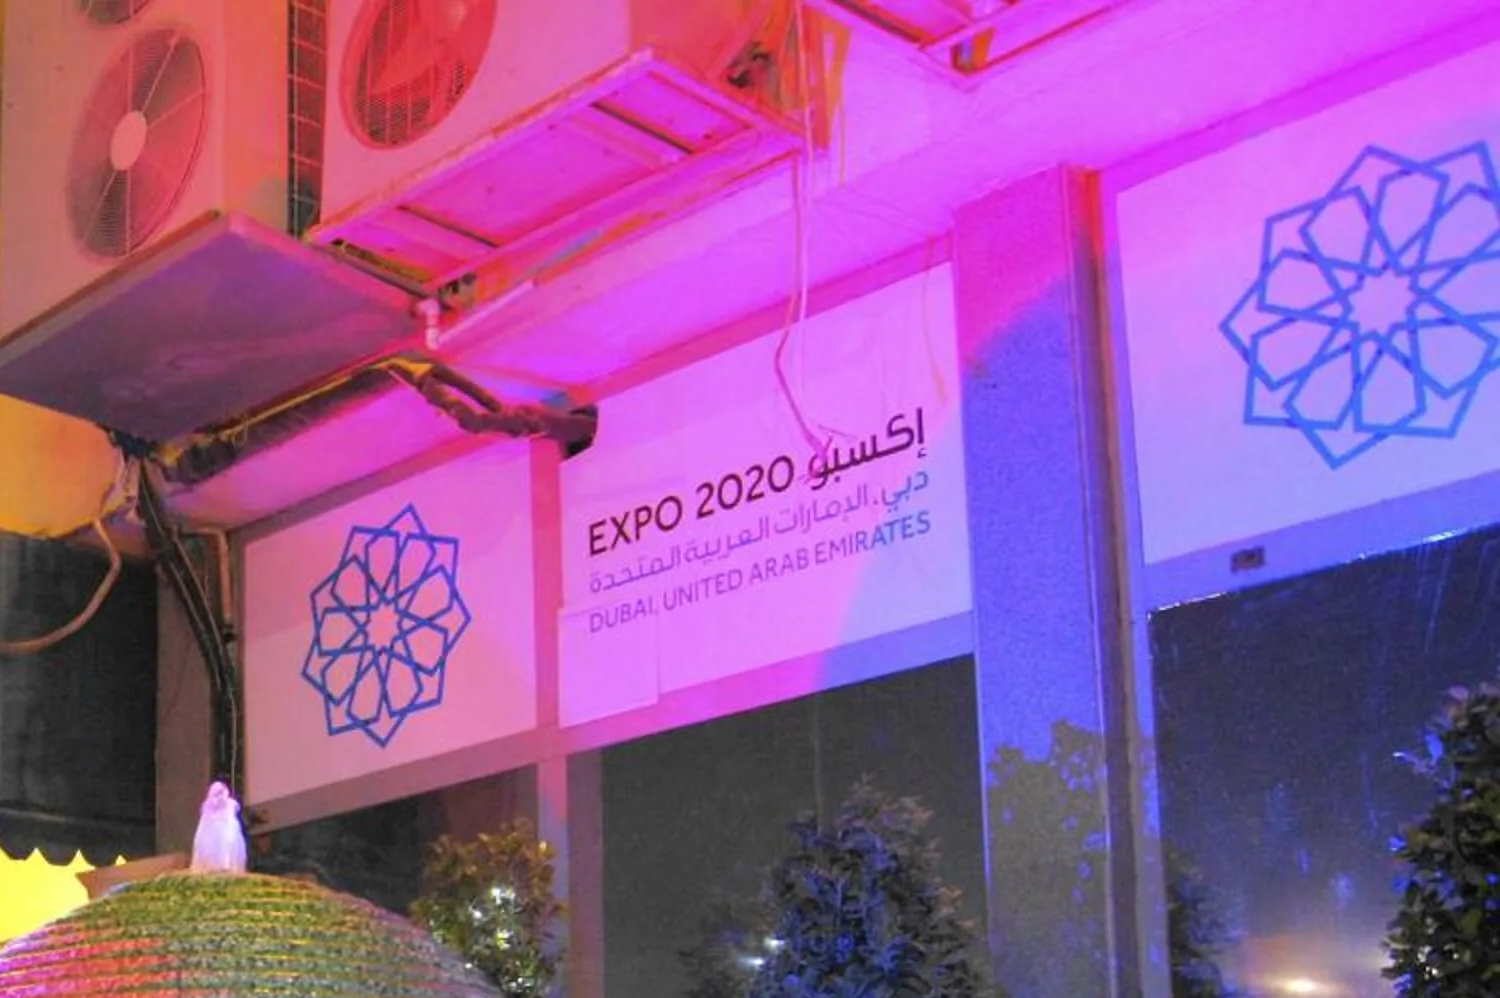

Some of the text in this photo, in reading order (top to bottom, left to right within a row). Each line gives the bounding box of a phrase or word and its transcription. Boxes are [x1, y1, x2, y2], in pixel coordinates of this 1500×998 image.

[588, 455, 794, 556] EXPO 2020
[589, 510, 931, 633] DUBAI, UNITED ARAB EMIRATES
